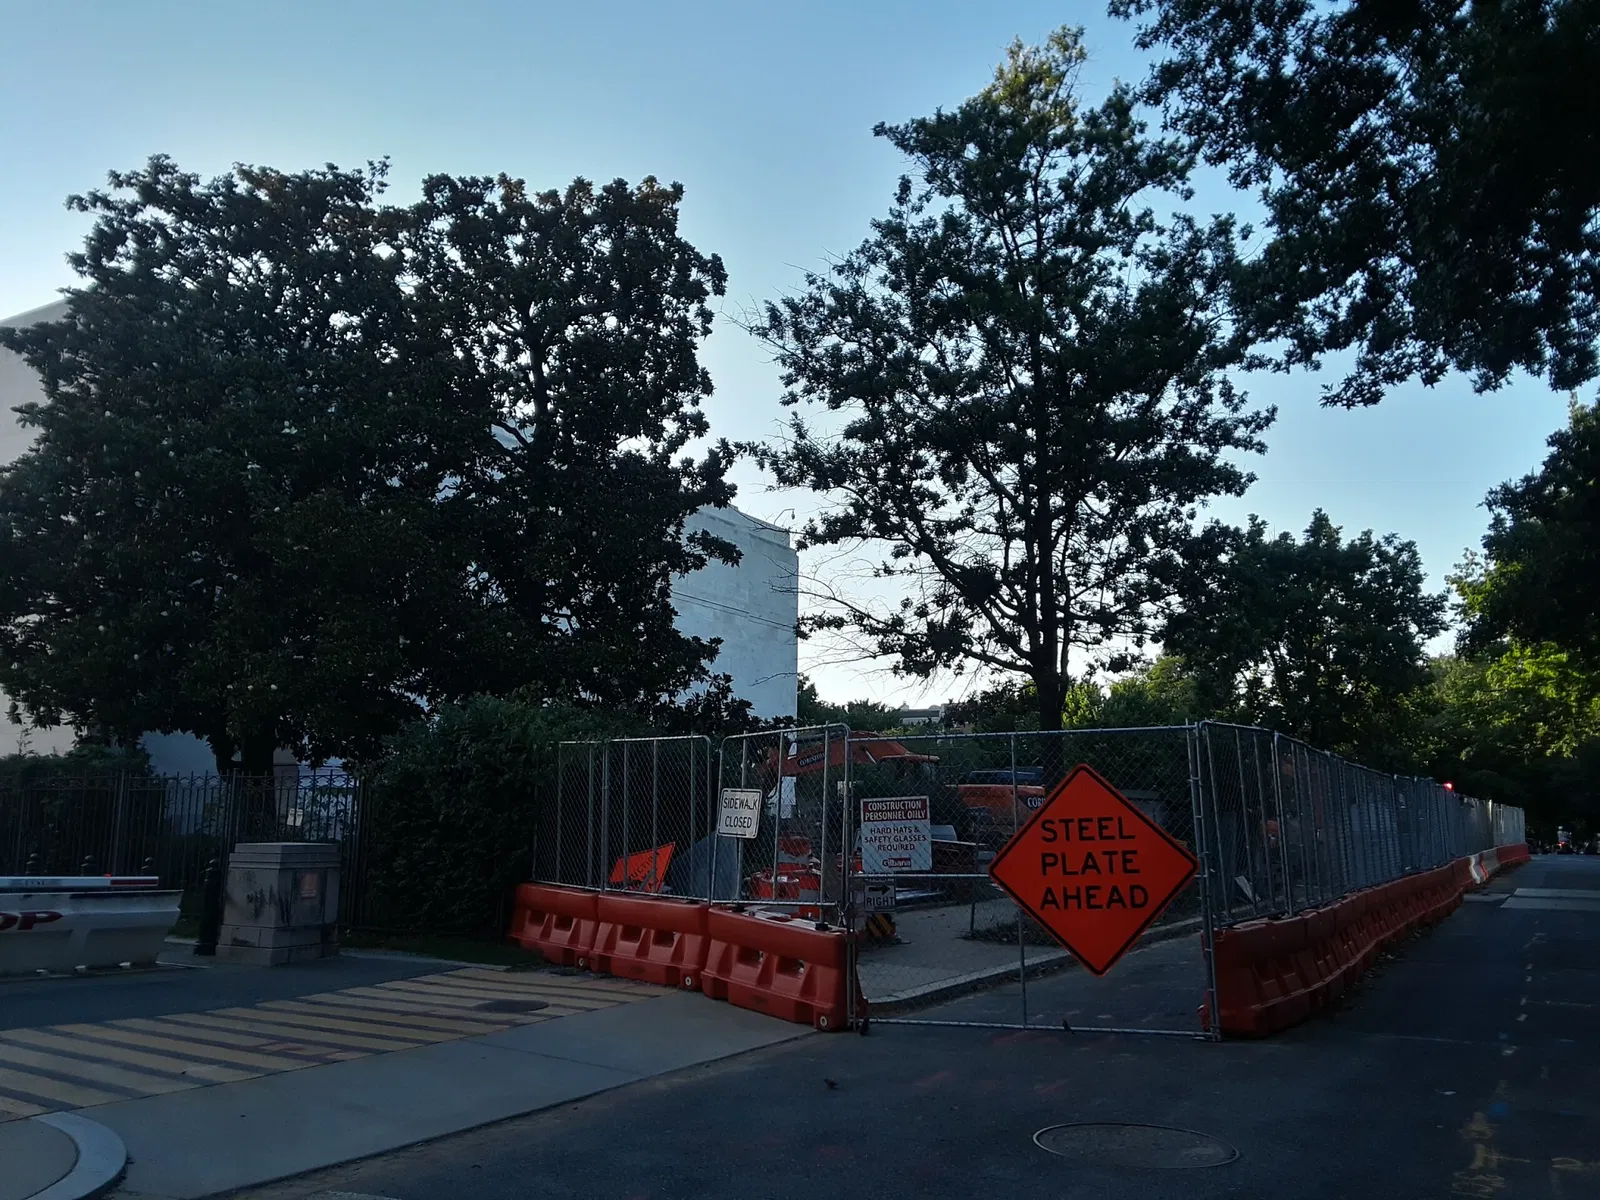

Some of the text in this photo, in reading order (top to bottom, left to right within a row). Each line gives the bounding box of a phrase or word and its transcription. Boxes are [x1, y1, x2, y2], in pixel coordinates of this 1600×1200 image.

[723, 797, 758, 810] SIDEWALK
[868, 800, 922, 811] CONSTRUCTION
[724, 815, 752, 829] CLOSED
[865, 810, 926, 821] PERSONNEL ONLY
[893, 826, 913, 834] HATS
[1041, 816, 1136, 842] STEEL
[1040, 849, 1140, 876] PLATE
[866, 897, 894, 906] RIGHT
[1039, 884, 1149, 910] AHEAD
